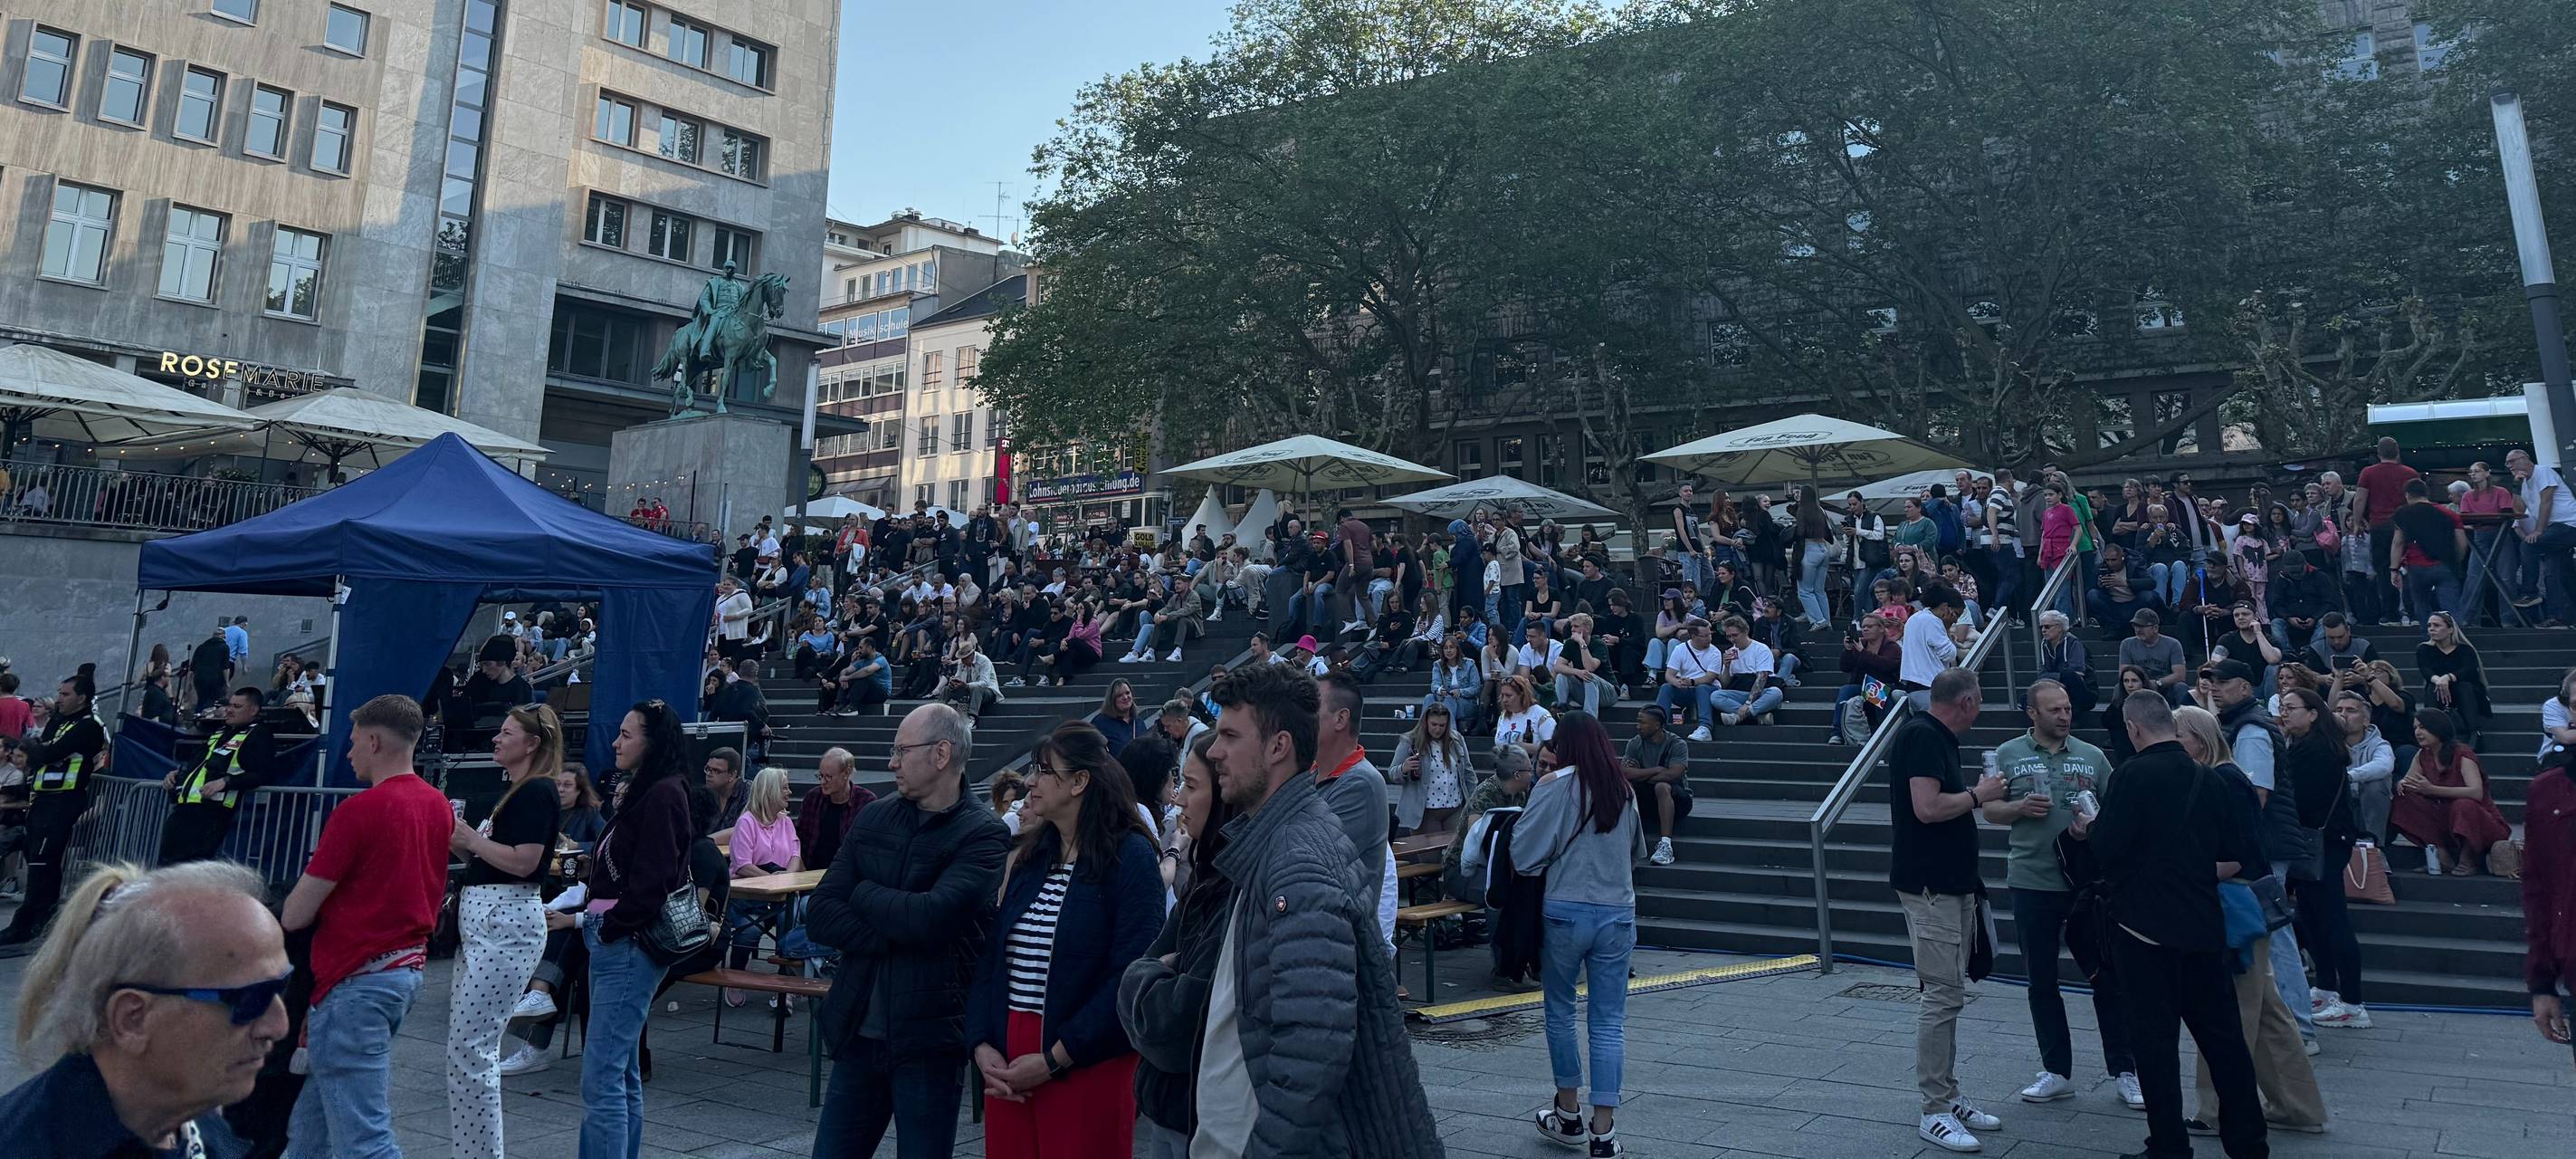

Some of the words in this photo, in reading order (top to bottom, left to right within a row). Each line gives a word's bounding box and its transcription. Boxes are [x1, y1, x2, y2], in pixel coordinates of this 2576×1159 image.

[160, 351, 326, 392] ROSEMARIE
[1135, 532, 1154, 541] GOLD
[2064, 762, 2094, 775] DAVID
